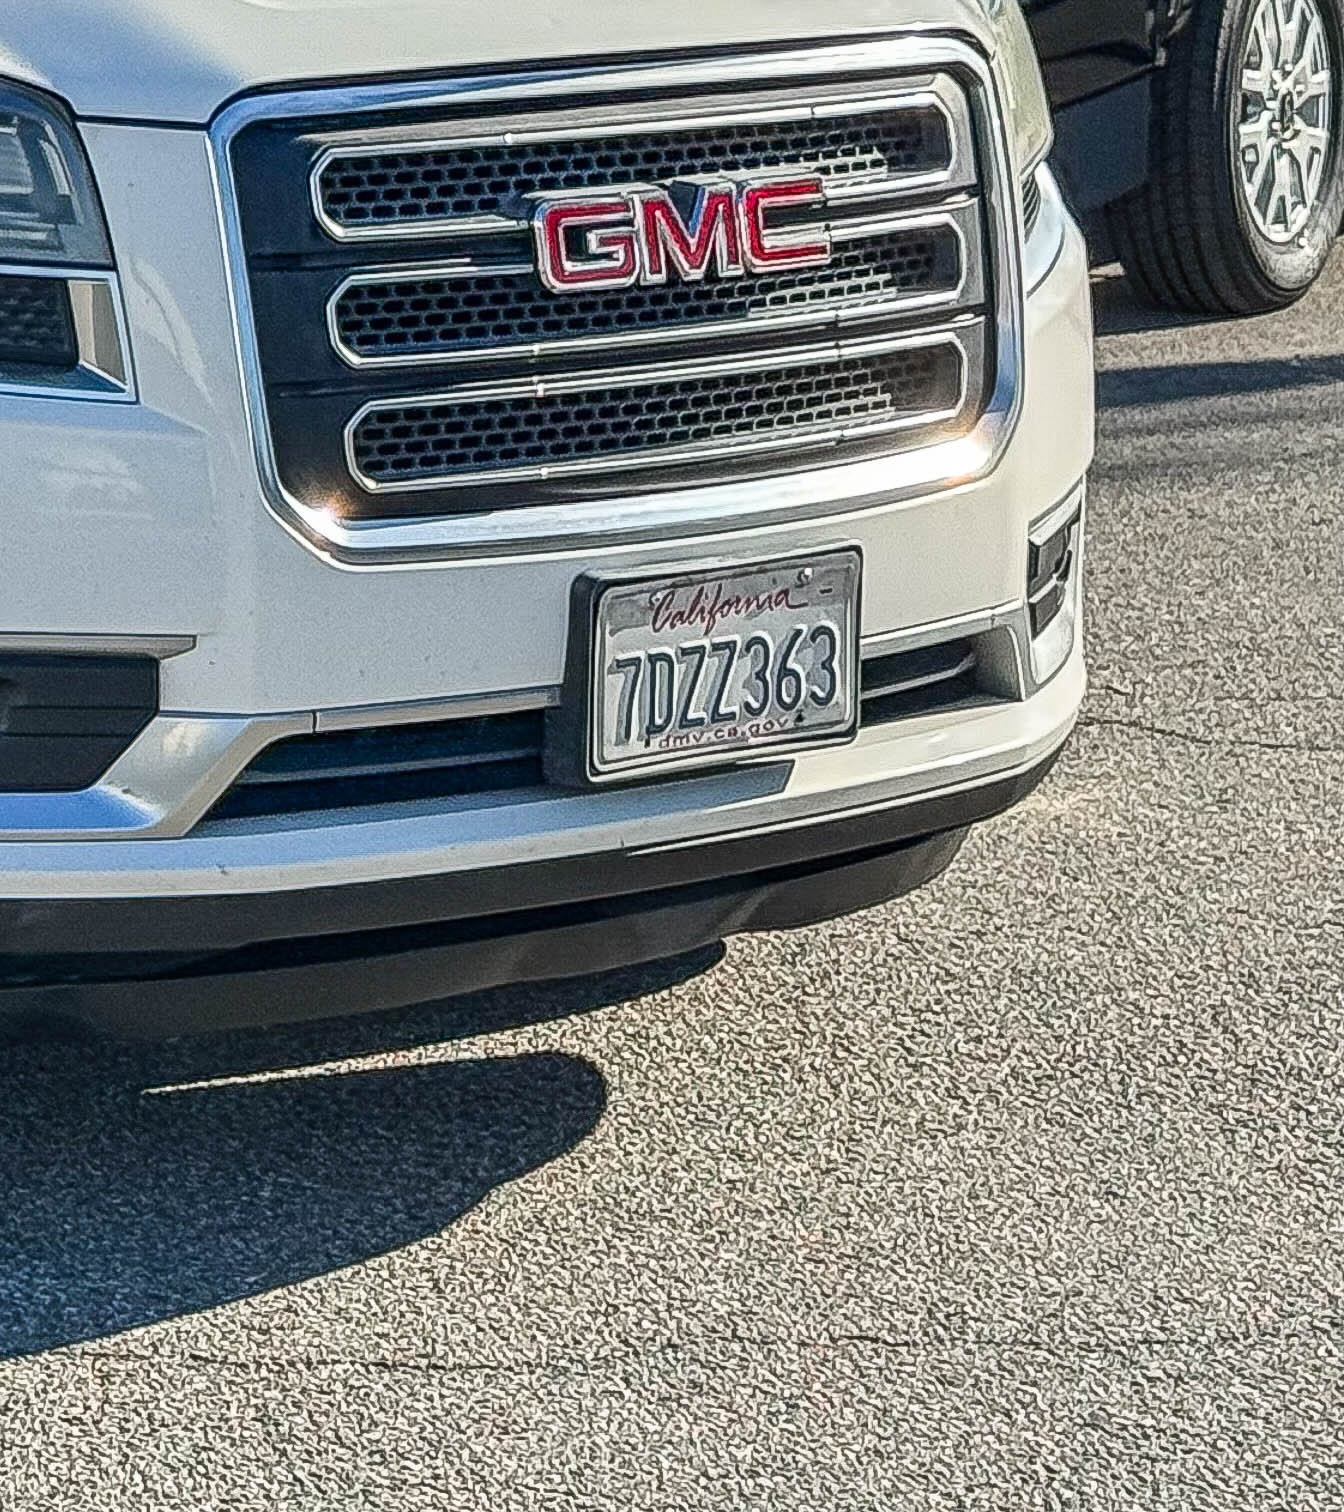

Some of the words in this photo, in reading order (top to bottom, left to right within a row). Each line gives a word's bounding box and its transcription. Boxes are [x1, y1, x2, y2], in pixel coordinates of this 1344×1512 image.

[534, 176, 832, 294] GMC
[651, 584, 809, 635] California
[612, 622, 840, 745] 7DZZ363
